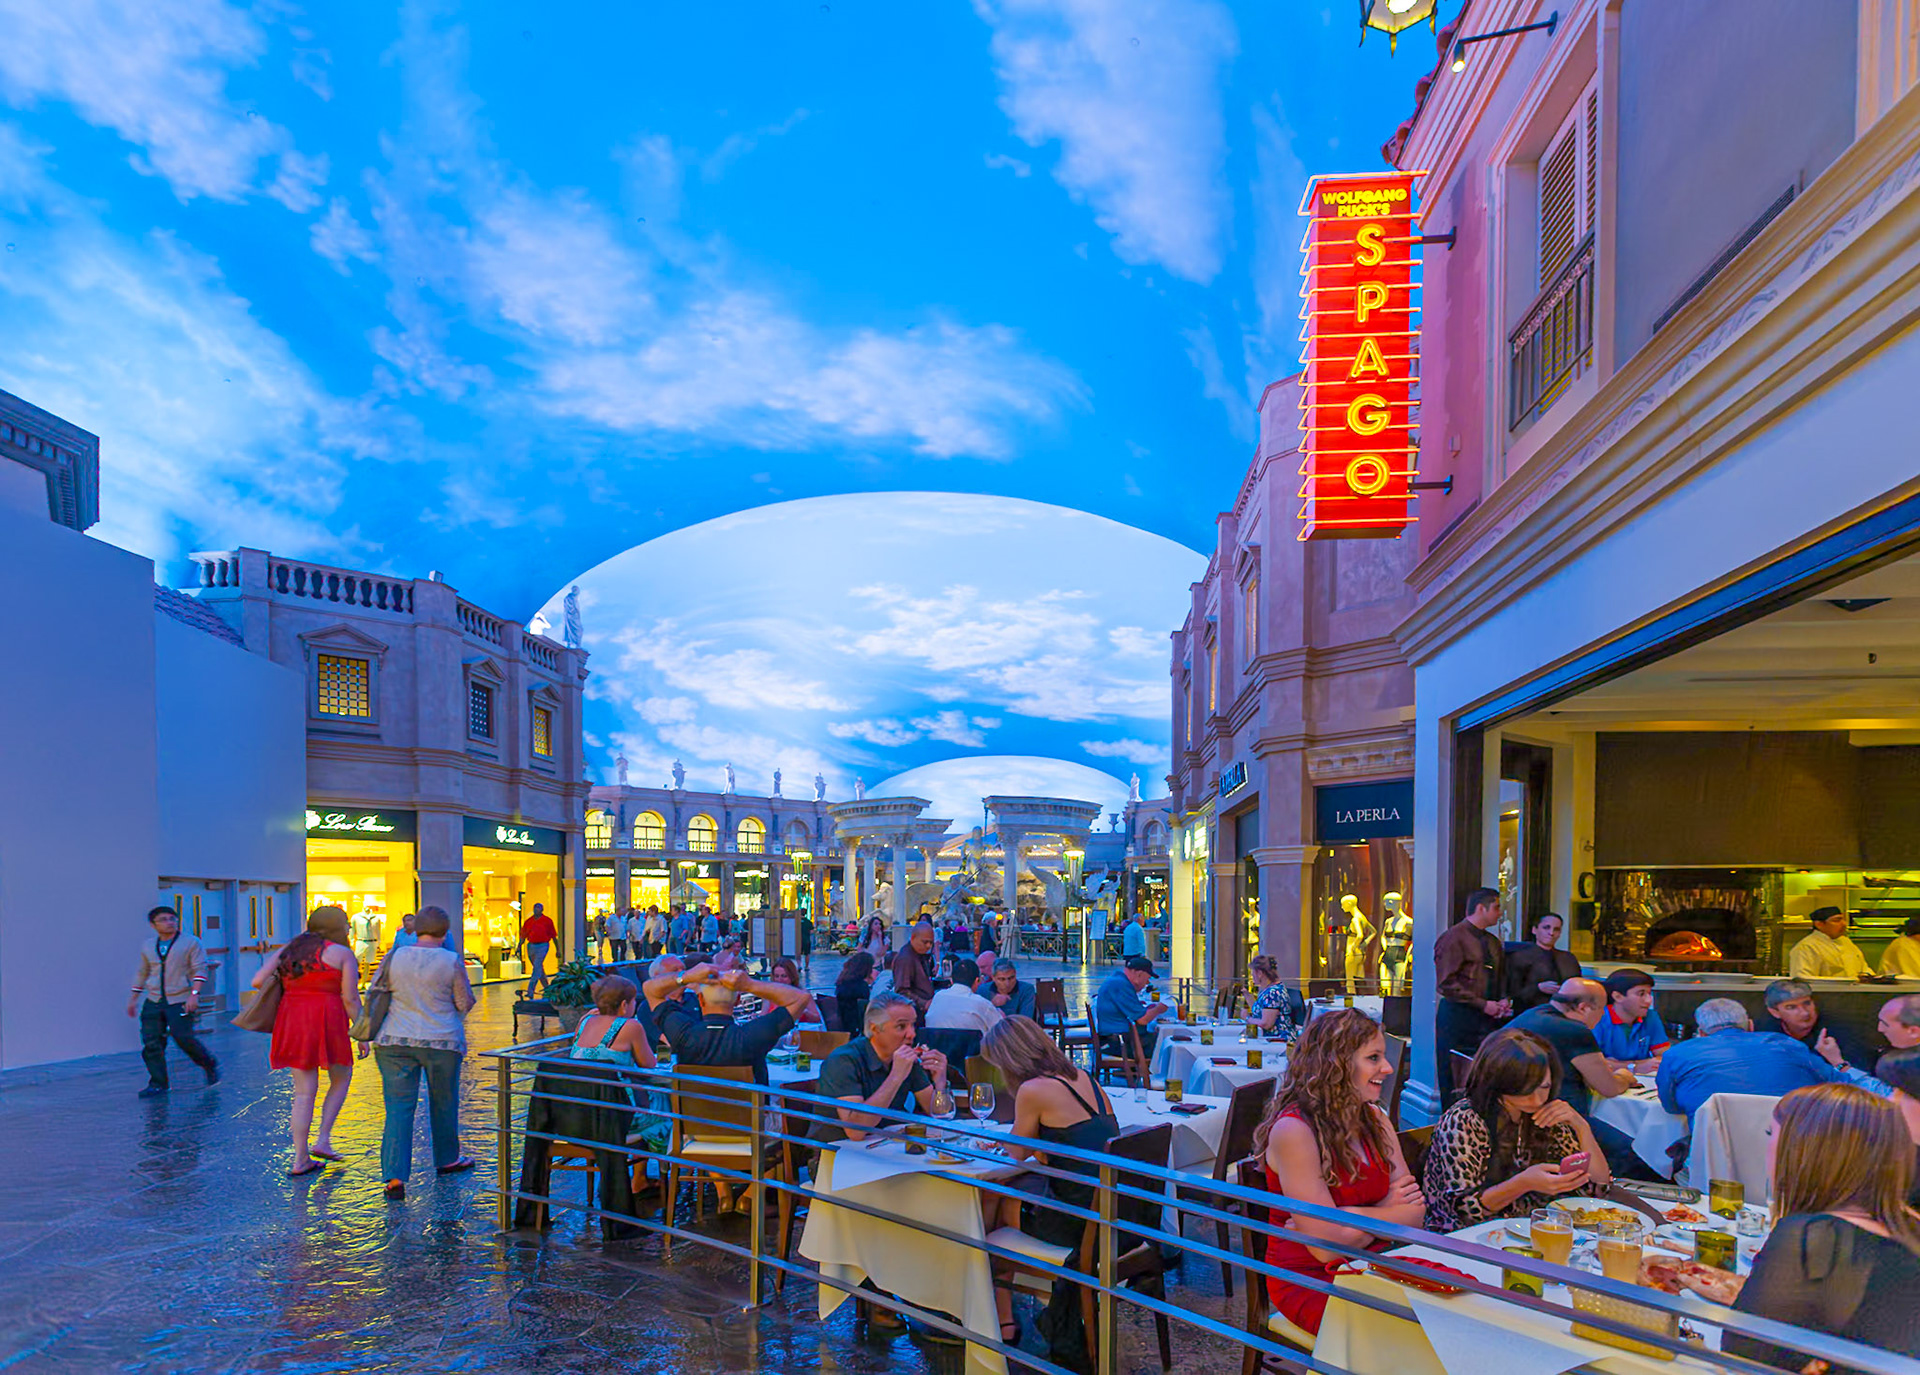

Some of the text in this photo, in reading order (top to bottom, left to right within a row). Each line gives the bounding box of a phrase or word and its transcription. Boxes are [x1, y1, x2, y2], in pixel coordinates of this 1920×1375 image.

[1322, 188, 1408, 205] WOLFGANG
[1337, 202, 1391, 217] PUCK'S
[1346, 223, 1392, 496] SPAGO
[1336, 807, 1400, 824] LA PERLA
